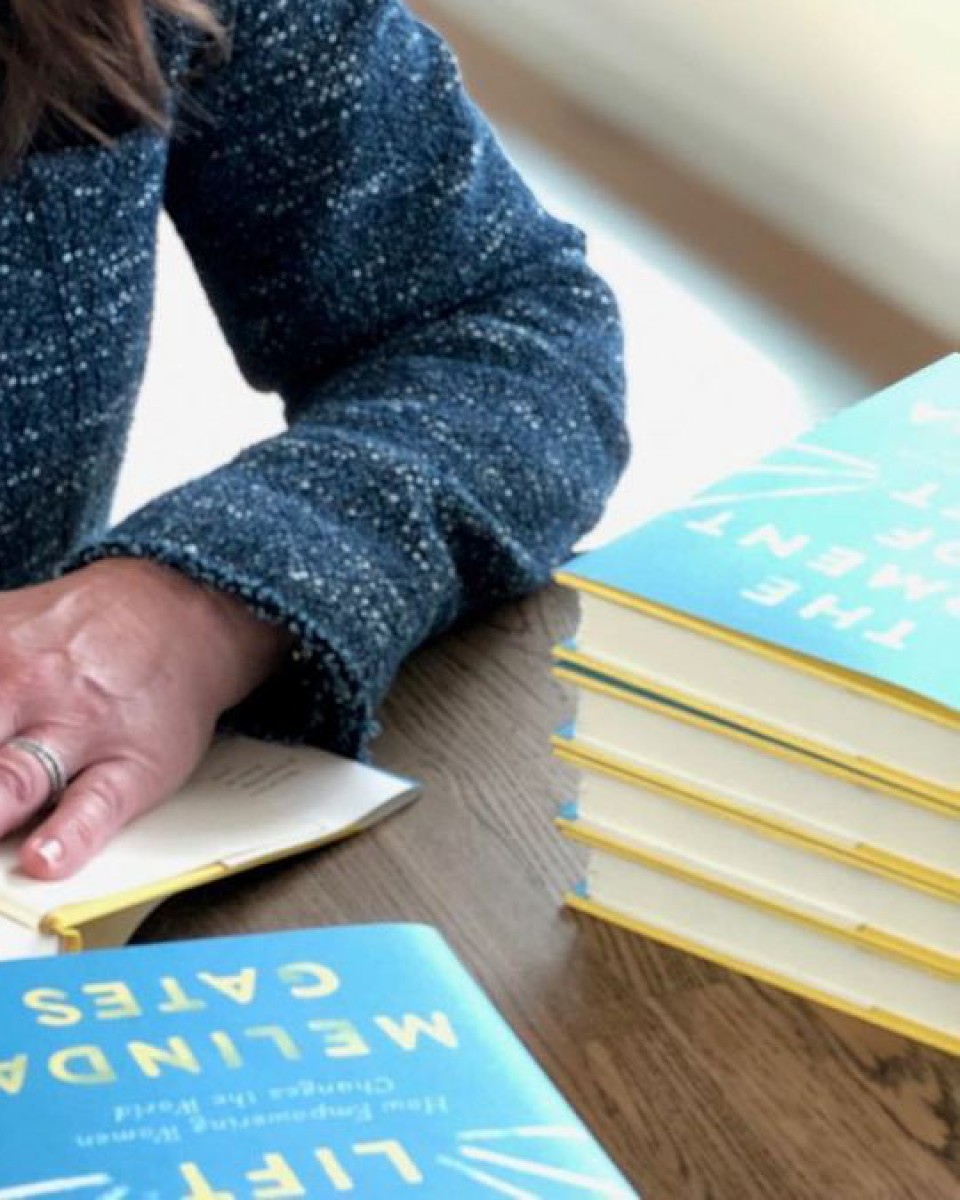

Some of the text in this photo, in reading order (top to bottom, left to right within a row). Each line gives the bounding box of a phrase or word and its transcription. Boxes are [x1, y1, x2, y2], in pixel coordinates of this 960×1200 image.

[740, 576, 915, 650] THE
[21, 961, 341, 1027] GATES
[76, 1095, 449, 1147] How Empowering Women
[113, 1076, 396, 1123] Changes the World
[180, 1139, 424, 1200] LIFT
